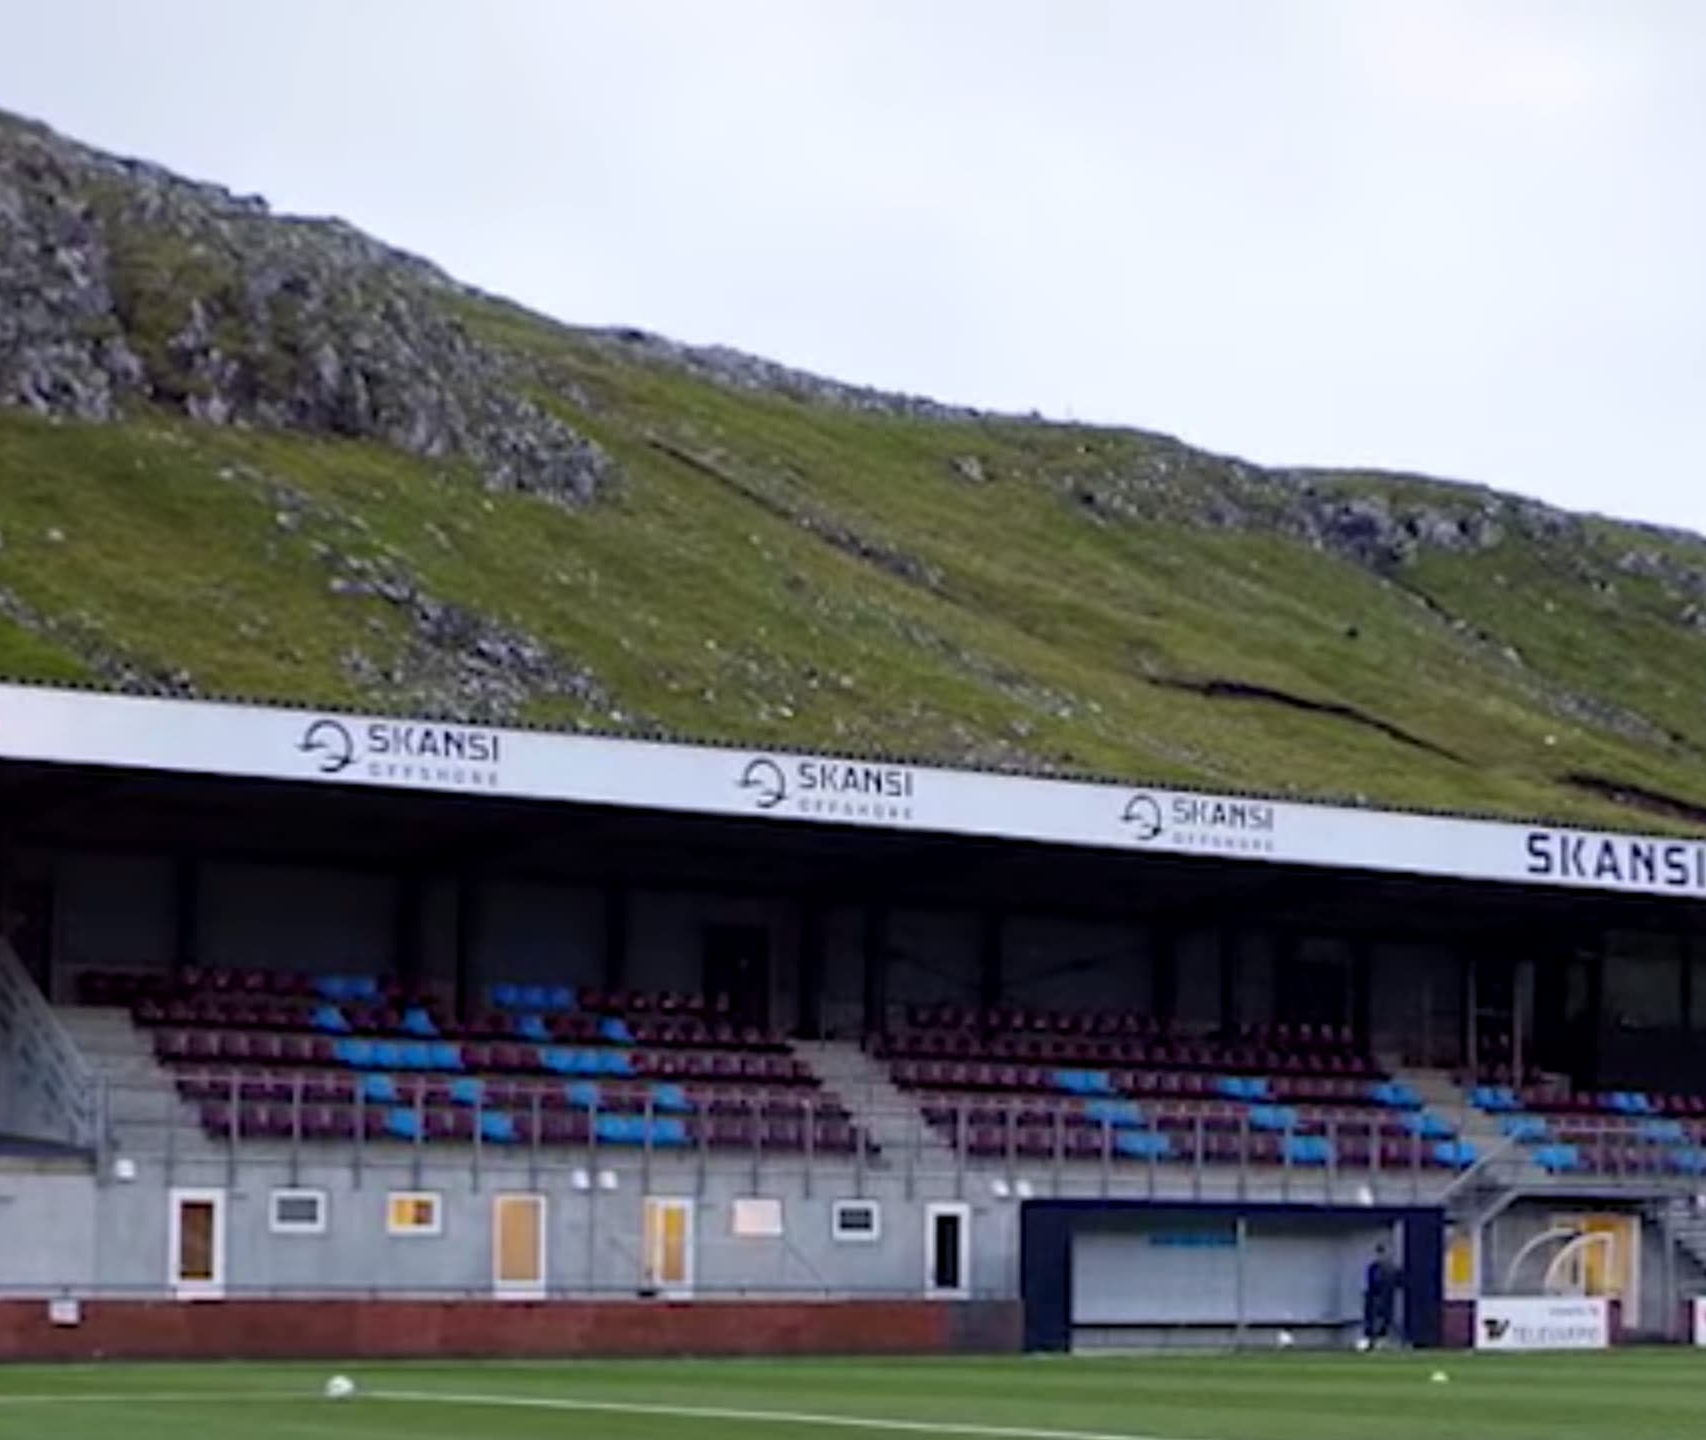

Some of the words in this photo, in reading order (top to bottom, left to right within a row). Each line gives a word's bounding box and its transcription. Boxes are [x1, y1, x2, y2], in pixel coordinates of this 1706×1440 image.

[367, 723, 499, 763] SKANSI
[798, 762, 915, 797] SKANSI
[1172, 798, 1275, 831] SKANSI
[1525, 832, 1706, 889] SKANSI
